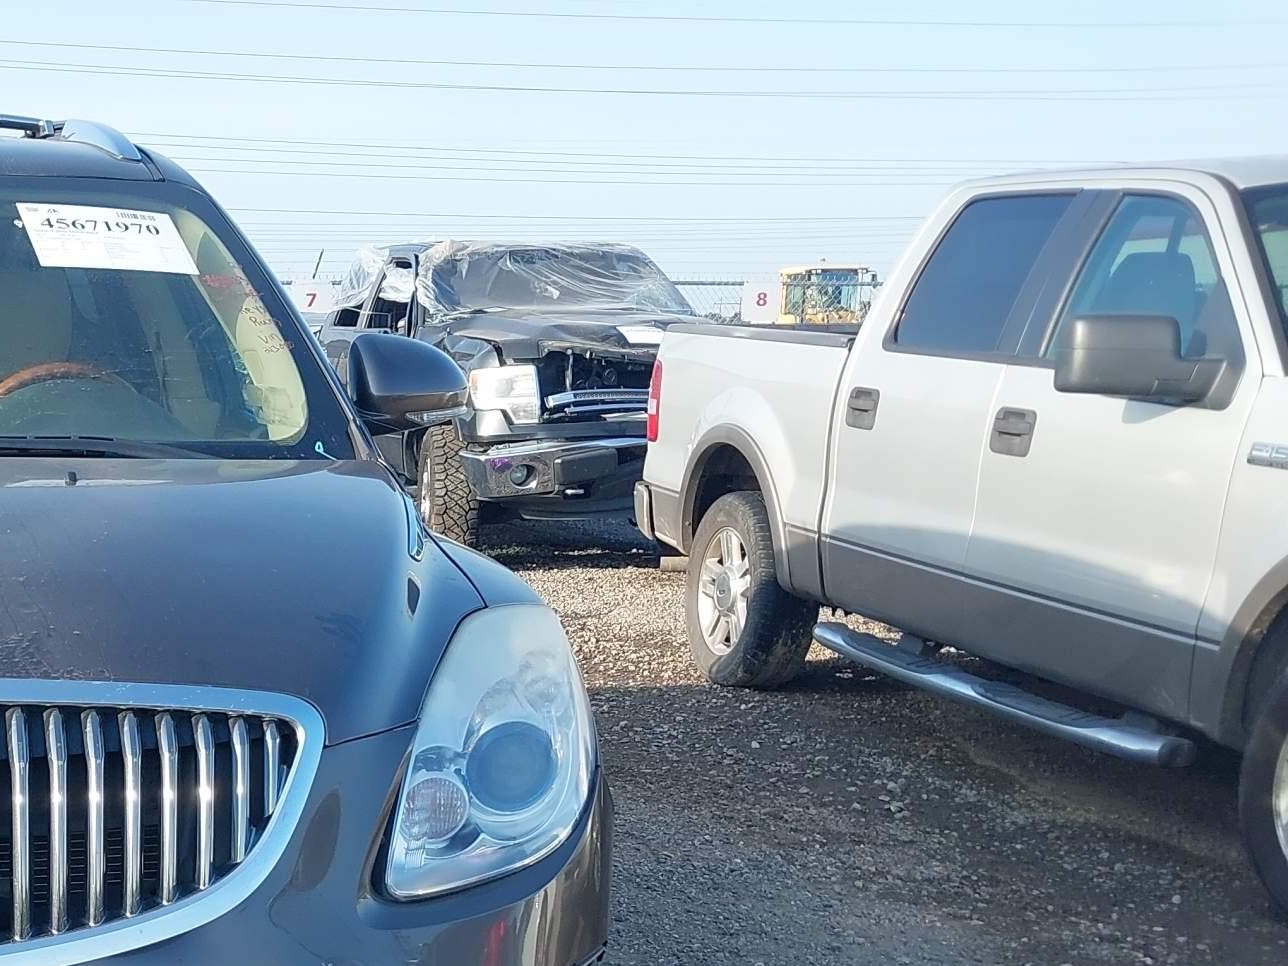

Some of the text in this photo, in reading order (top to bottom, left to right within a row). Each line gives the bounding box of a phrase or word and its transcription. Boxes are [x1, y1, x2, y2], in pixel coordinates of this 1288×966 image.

[40, 217, 161, 236] 45671970
[306, 293, 317, 307] 7
[756, 292, 768, 306] 8
